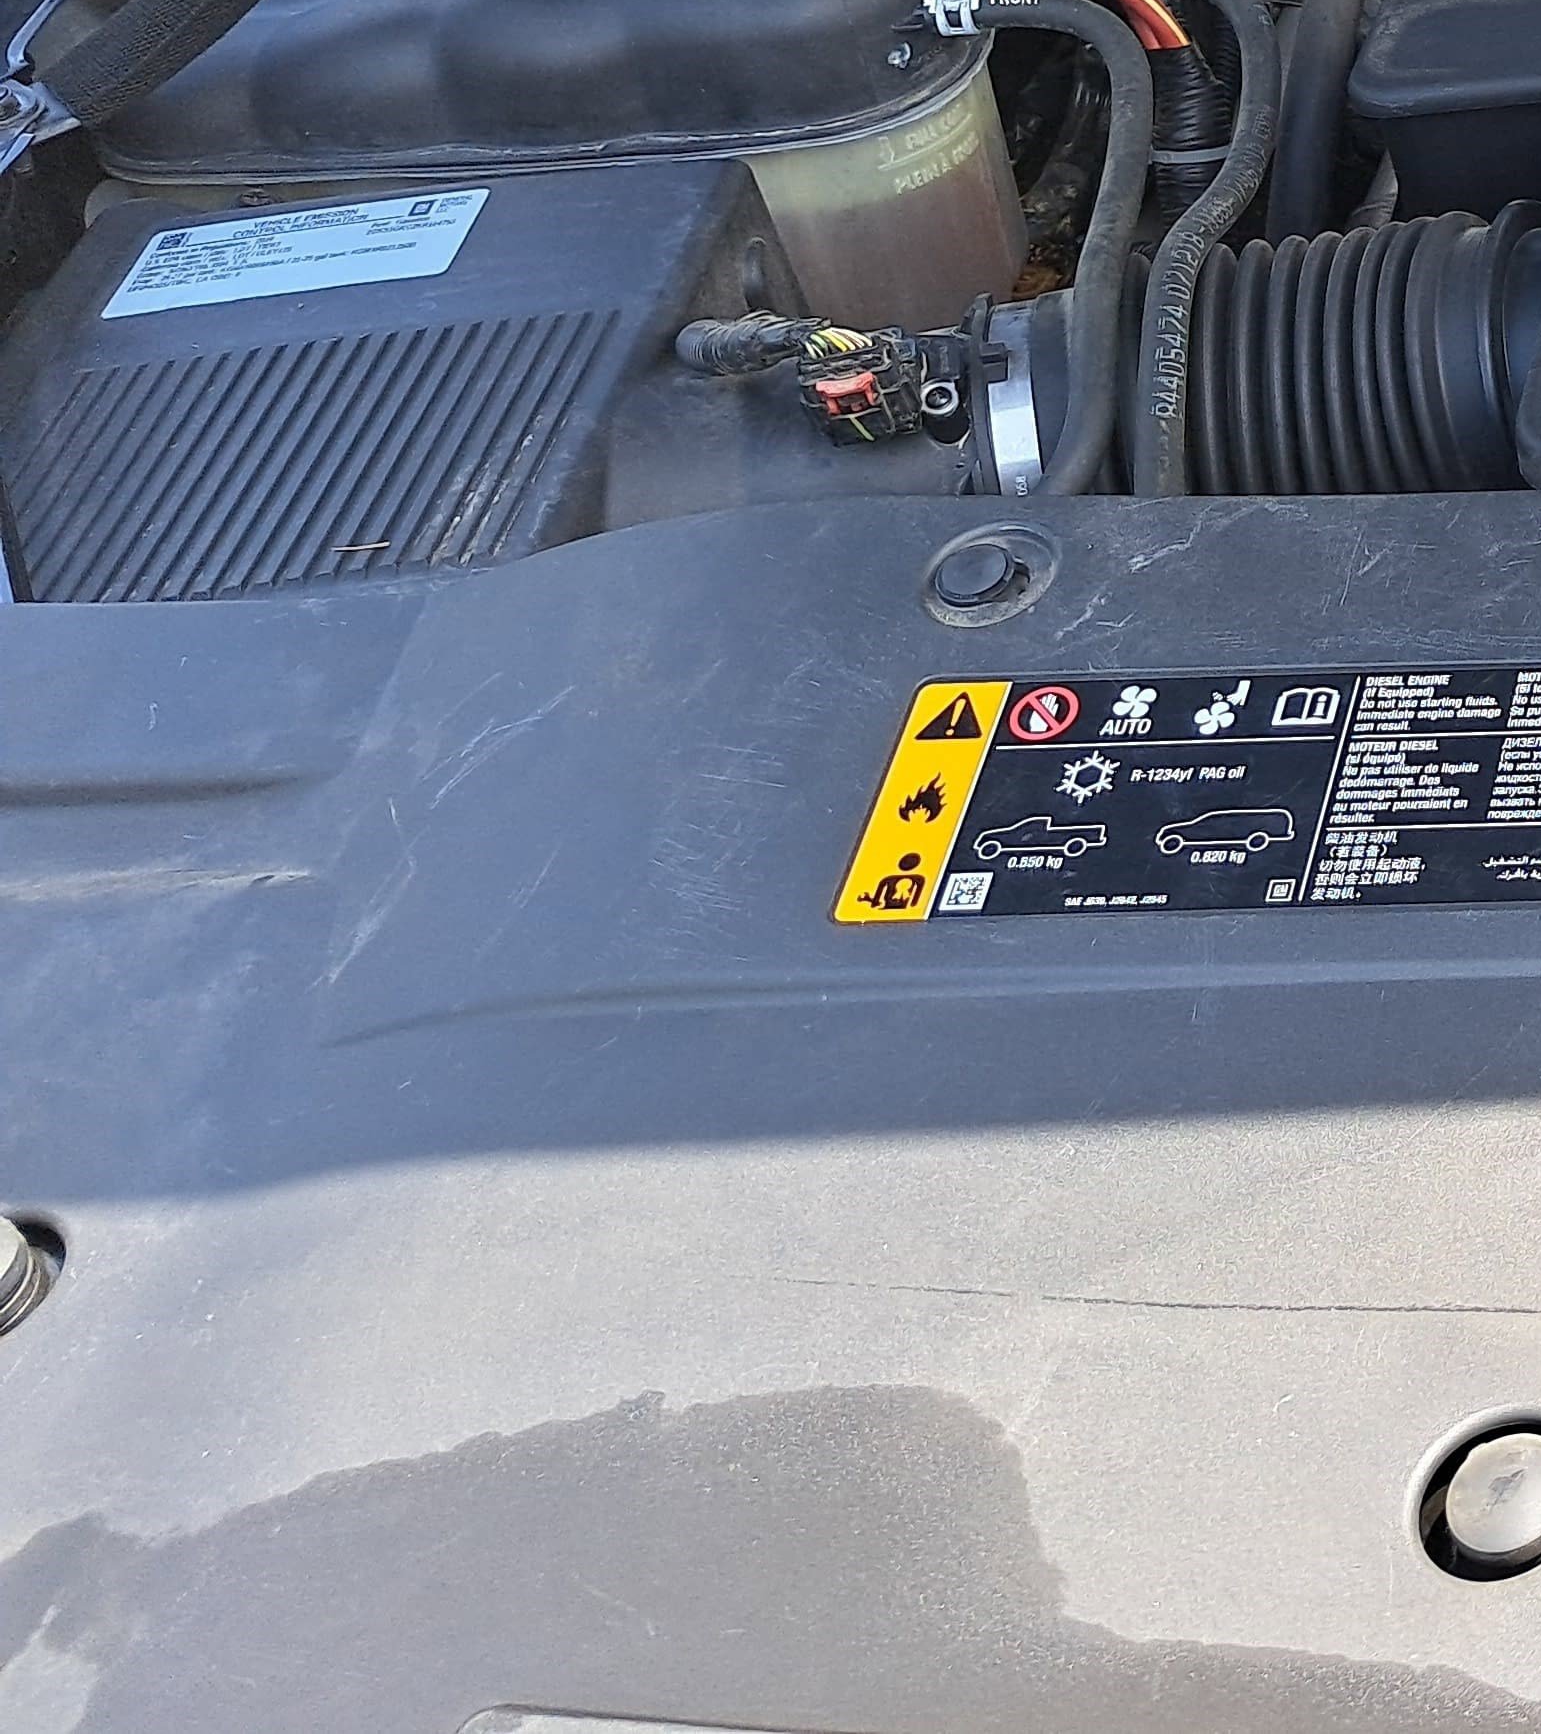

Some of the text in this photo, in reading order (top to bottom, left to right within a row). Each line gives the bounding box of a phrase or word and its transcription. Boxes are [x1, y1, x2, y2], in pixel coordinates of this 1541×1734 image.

[253, 215, 303, 229] VEHICLE
[232, 226, 285, 239] CONTROL
[1366, 675, 1451, 686] DIESEL ENGINE
[1378, 687, 1434, 699] Equipped)
[1360, 696, 1498, 709] Do not use starting fluids.
[1512, 695, 1527, 705] No
[1357, 708, 1501, 720] Immediate engine damage
[1510, 706, 1524, 716] Se
[1099, 718, 1152, 736] AUTO
[1354, 721, 1411, 731] can result.
[1349, 740, 1438, 752] MOTEUR DIESEL
[1501, 750, 1530, 760] (если
[1342, 762, 1479, 777] Ne pas utiliser de liquide
[1498, 762, 1513, 771] Не
[1131, 766, 1245, 782] R-1234yf PAG oil
[1419, 776, 1440, 785] Des
[1336, 787, 1460, 800] dommages immédiats
[1333, 799, 1468, 812] au moteur pourraient en
[1329, 813, 1374, 824] résulter.
[1046, 856, 1063, 870] kg
[1191, 851, 1246, 864] 0.820 kg
